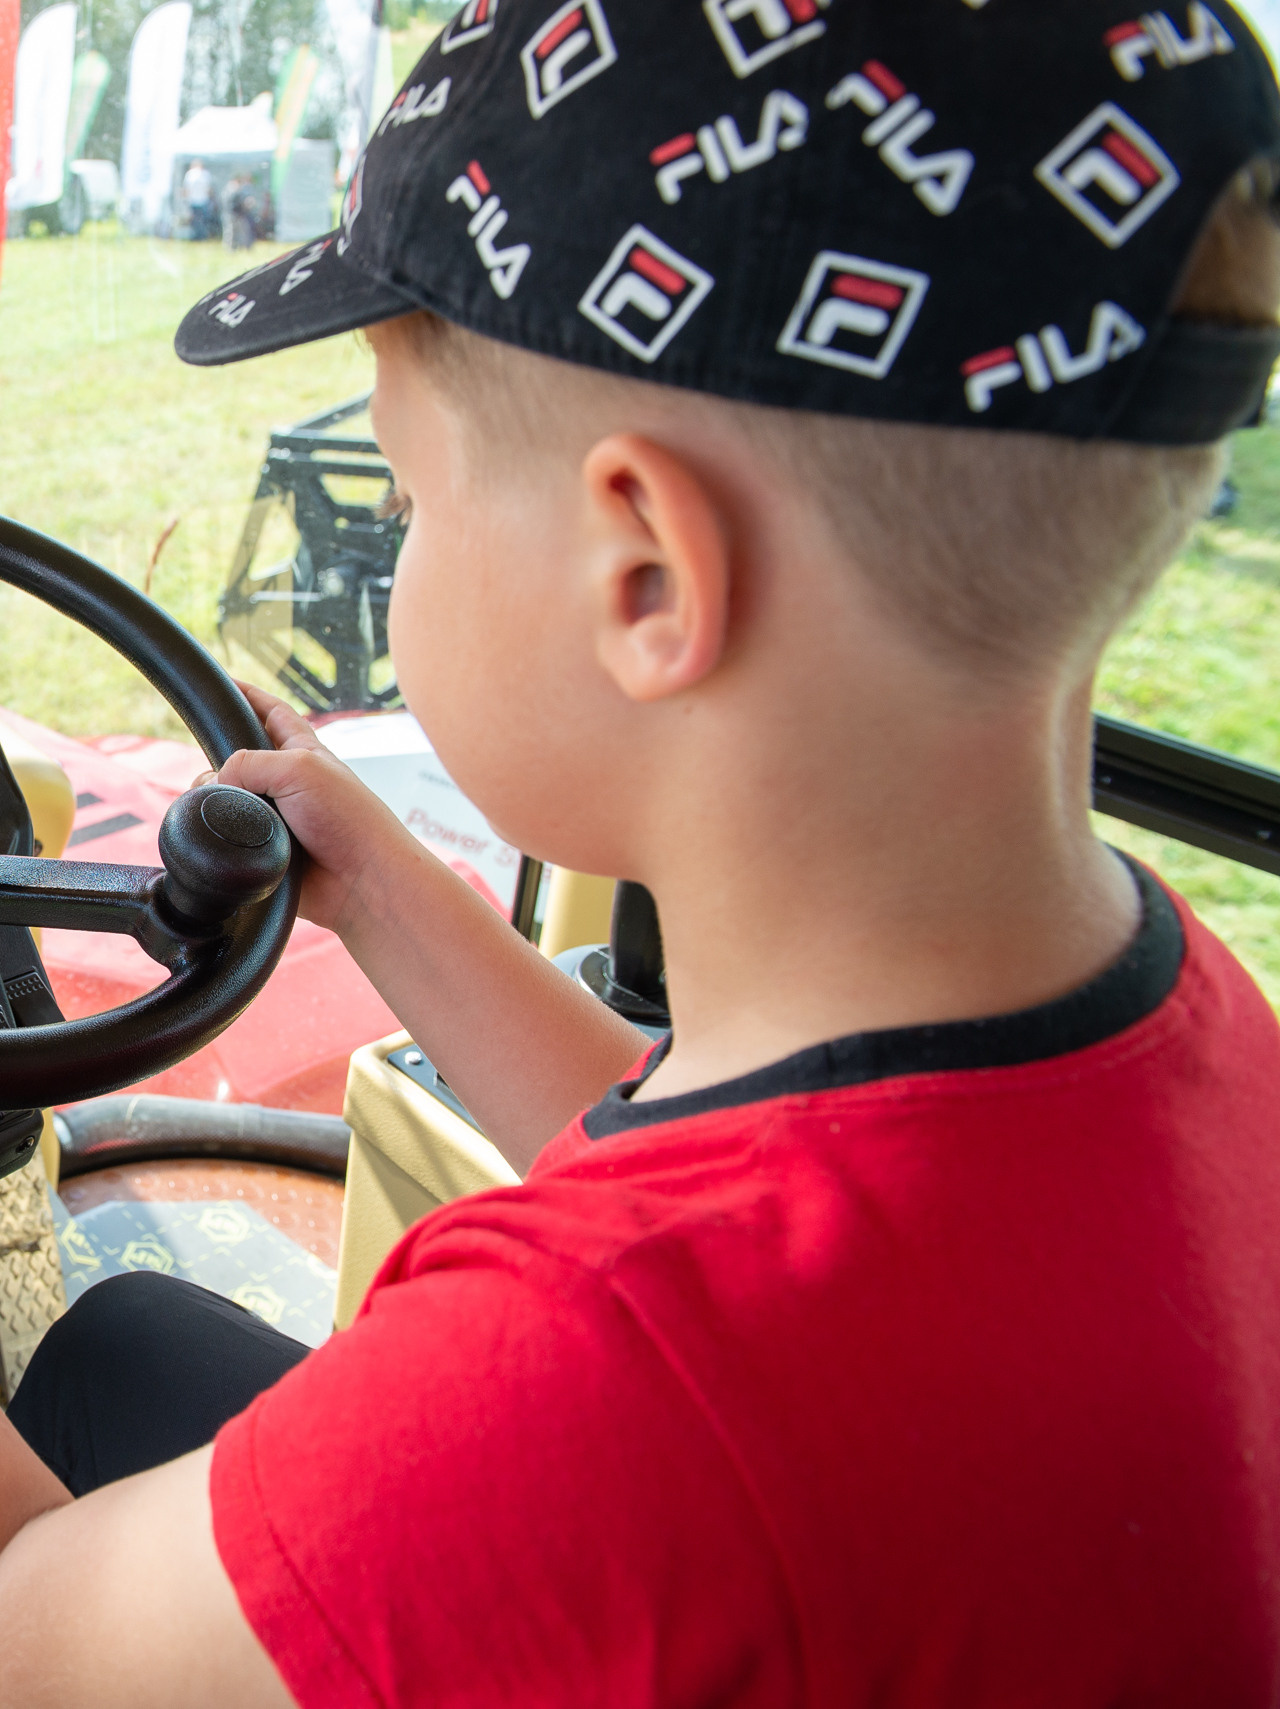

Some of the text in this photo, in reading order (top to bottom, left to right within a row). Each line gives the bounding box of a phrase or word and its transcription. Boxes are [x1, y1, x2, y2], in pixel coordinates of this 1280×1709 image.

[1103, 0, 1236, 82] FILA
[377, 76, 452, 137] FILA
[649, 89, 809, 204] FILA
[825, 59, 975, 216] FILA
[445, 159, 531, 299] FILA
[208, 292, 256, 328] FILA
[960, 301, 1145, 413] FILA
[406, 807, 489, 854] Power
